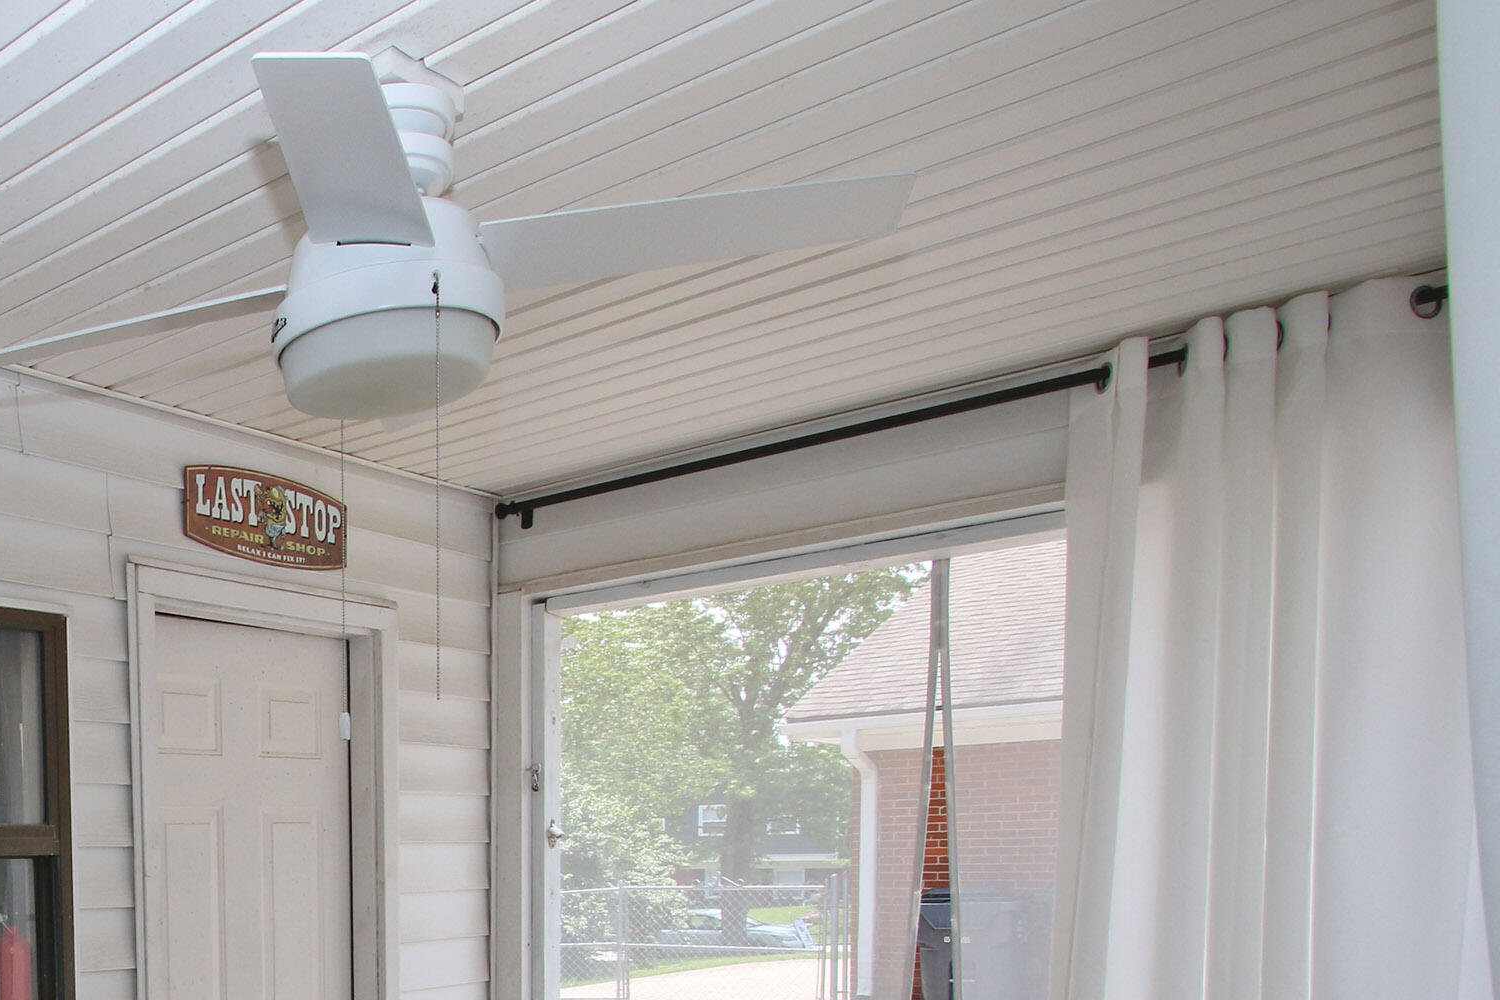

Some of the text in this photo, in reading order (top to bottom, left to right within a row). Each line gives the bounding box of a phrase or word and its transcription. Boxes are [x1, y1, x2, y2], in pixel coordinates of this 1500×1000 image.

[195, 474, 341, 544] LAST STOP
[212, 525, 326, 556] REPAIR SHOP
[237, 544, 261, 556] RELAX
[268, 552, 281, 561] CAN
